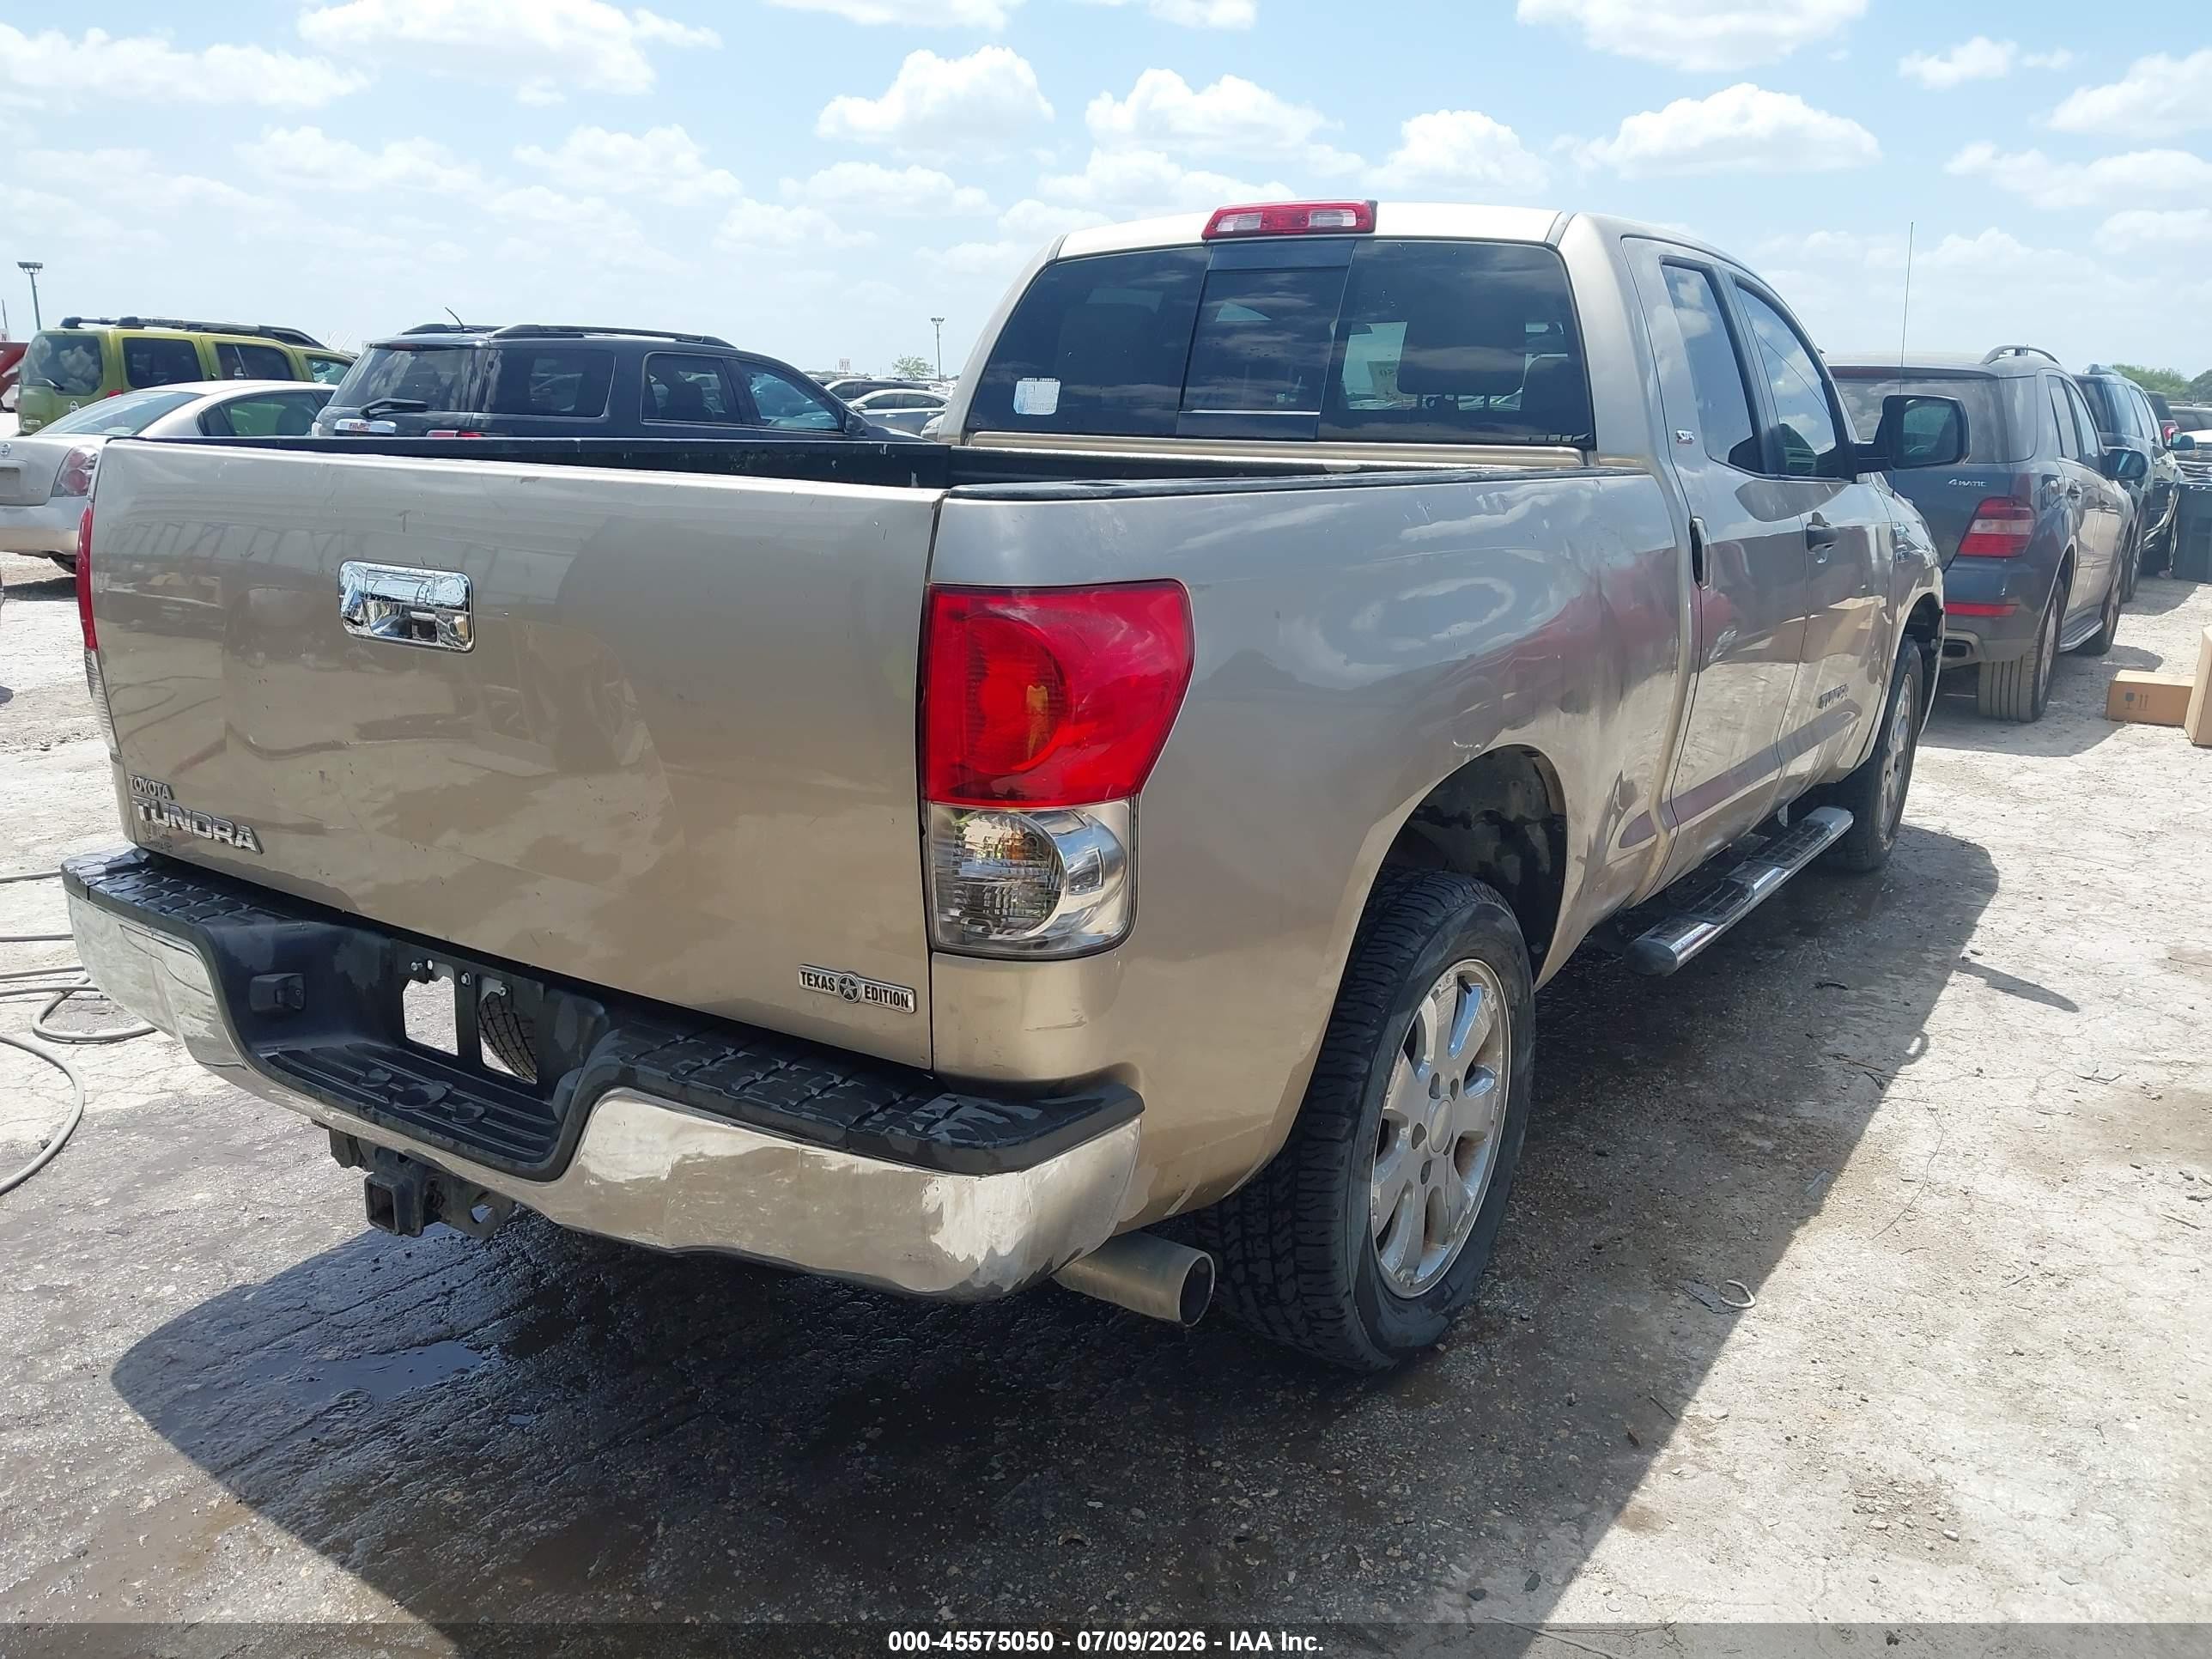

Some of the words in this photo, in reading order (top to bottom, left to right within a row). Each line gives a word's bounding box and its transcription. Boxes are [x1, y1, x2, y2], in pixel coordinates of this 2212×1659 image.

[130, 775, 174, 800] TOYOTA
[131, 795, 264, 854] TUNDRA
[800, 971, 836, 992] TEXAS
[865, 985, 909, 1008] EDITION
